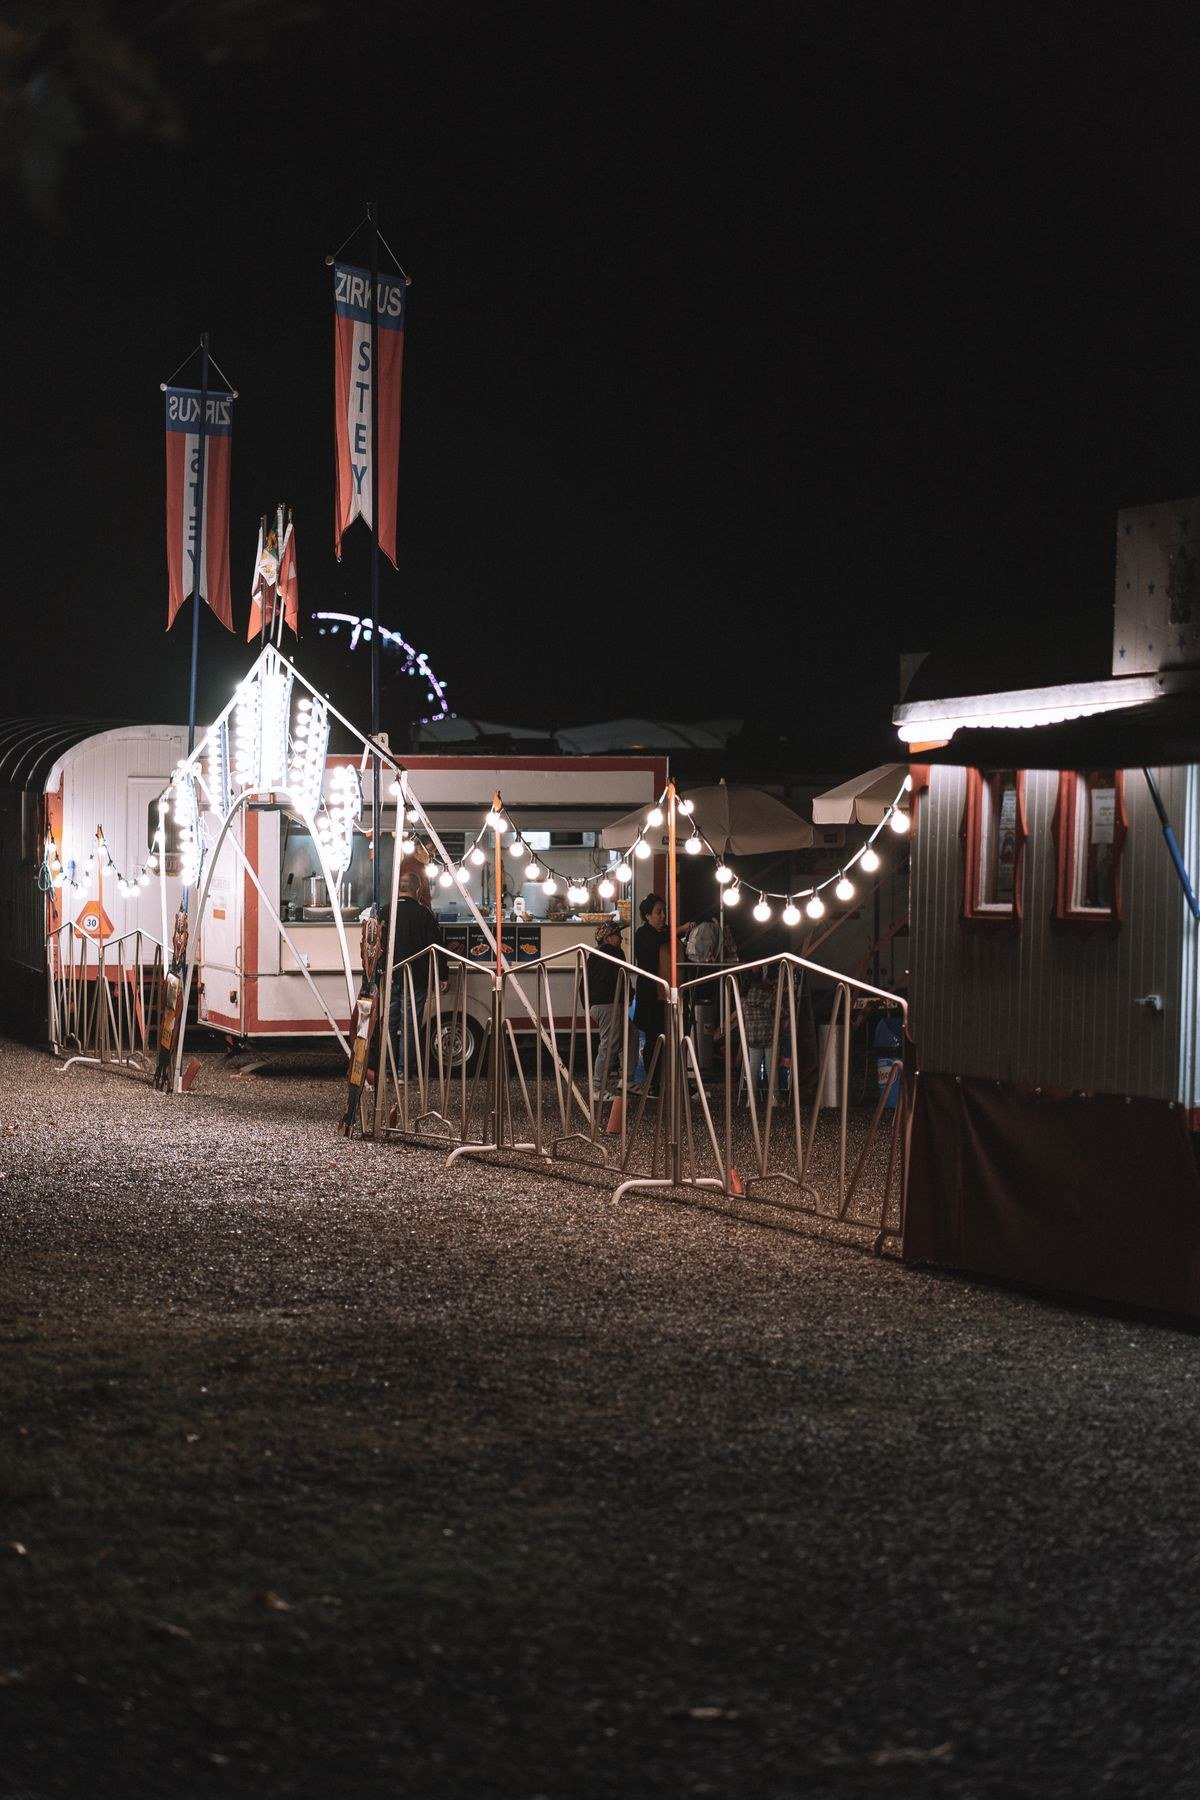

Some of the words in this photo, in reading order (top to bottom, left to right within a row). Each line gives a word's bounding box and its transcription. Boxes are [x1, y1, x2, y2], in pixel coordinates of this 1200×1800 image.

[334, 271, 402, 317] ZIRKUS
[351, 341, 371, 495] STEY
[86, 919, 97, 927] 30
